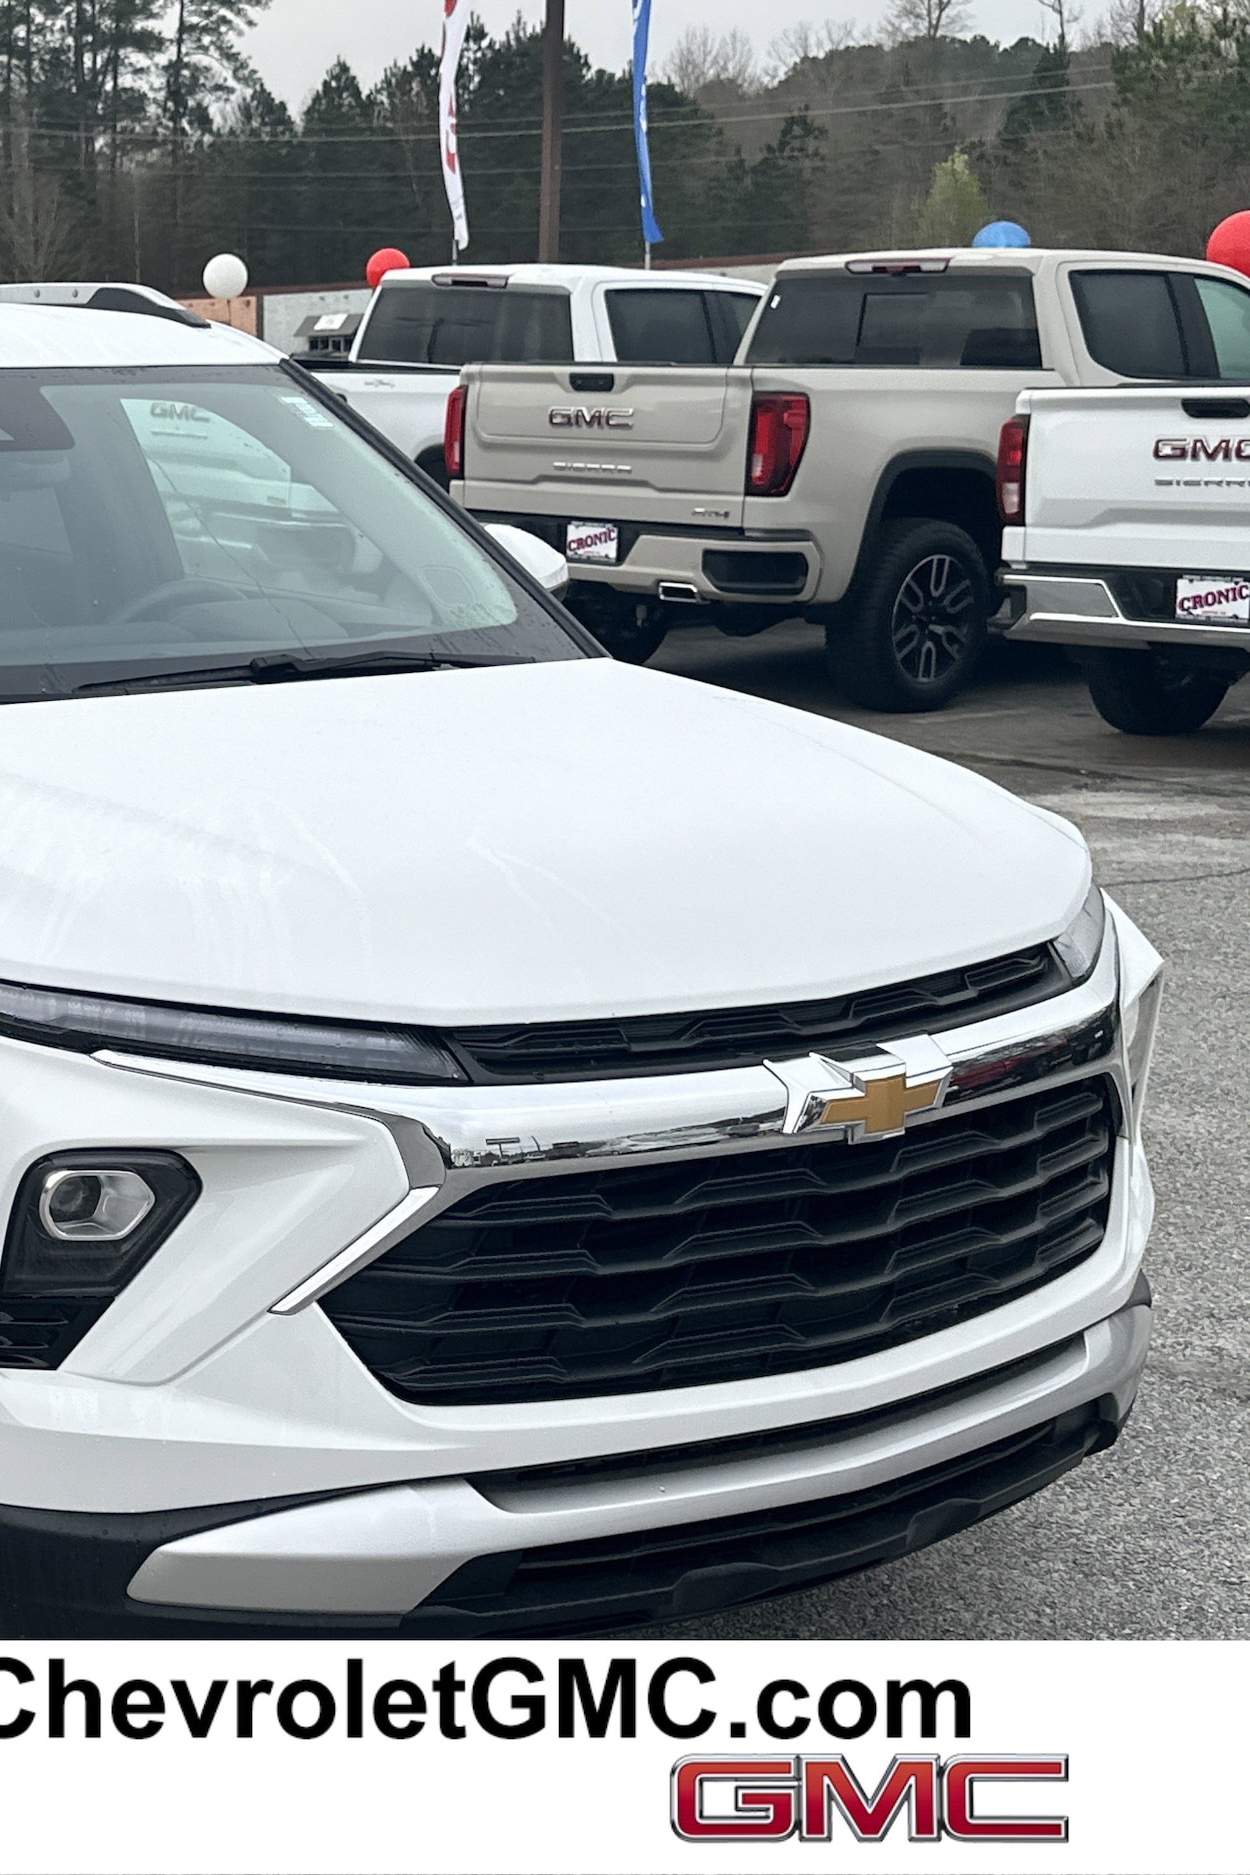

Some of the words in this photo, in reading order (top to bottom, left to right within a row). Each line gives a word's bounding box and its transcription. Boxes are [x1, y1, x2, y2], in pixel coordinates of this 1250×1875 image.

[150, 402, 211, 423] GMC
[549, 406, 634, 431] GMC
[1153, 475, 1250, 488] SIERR
[568, 527, 616, 552] CRONIC
[1177, 584, 1250, 612] CRONIC
